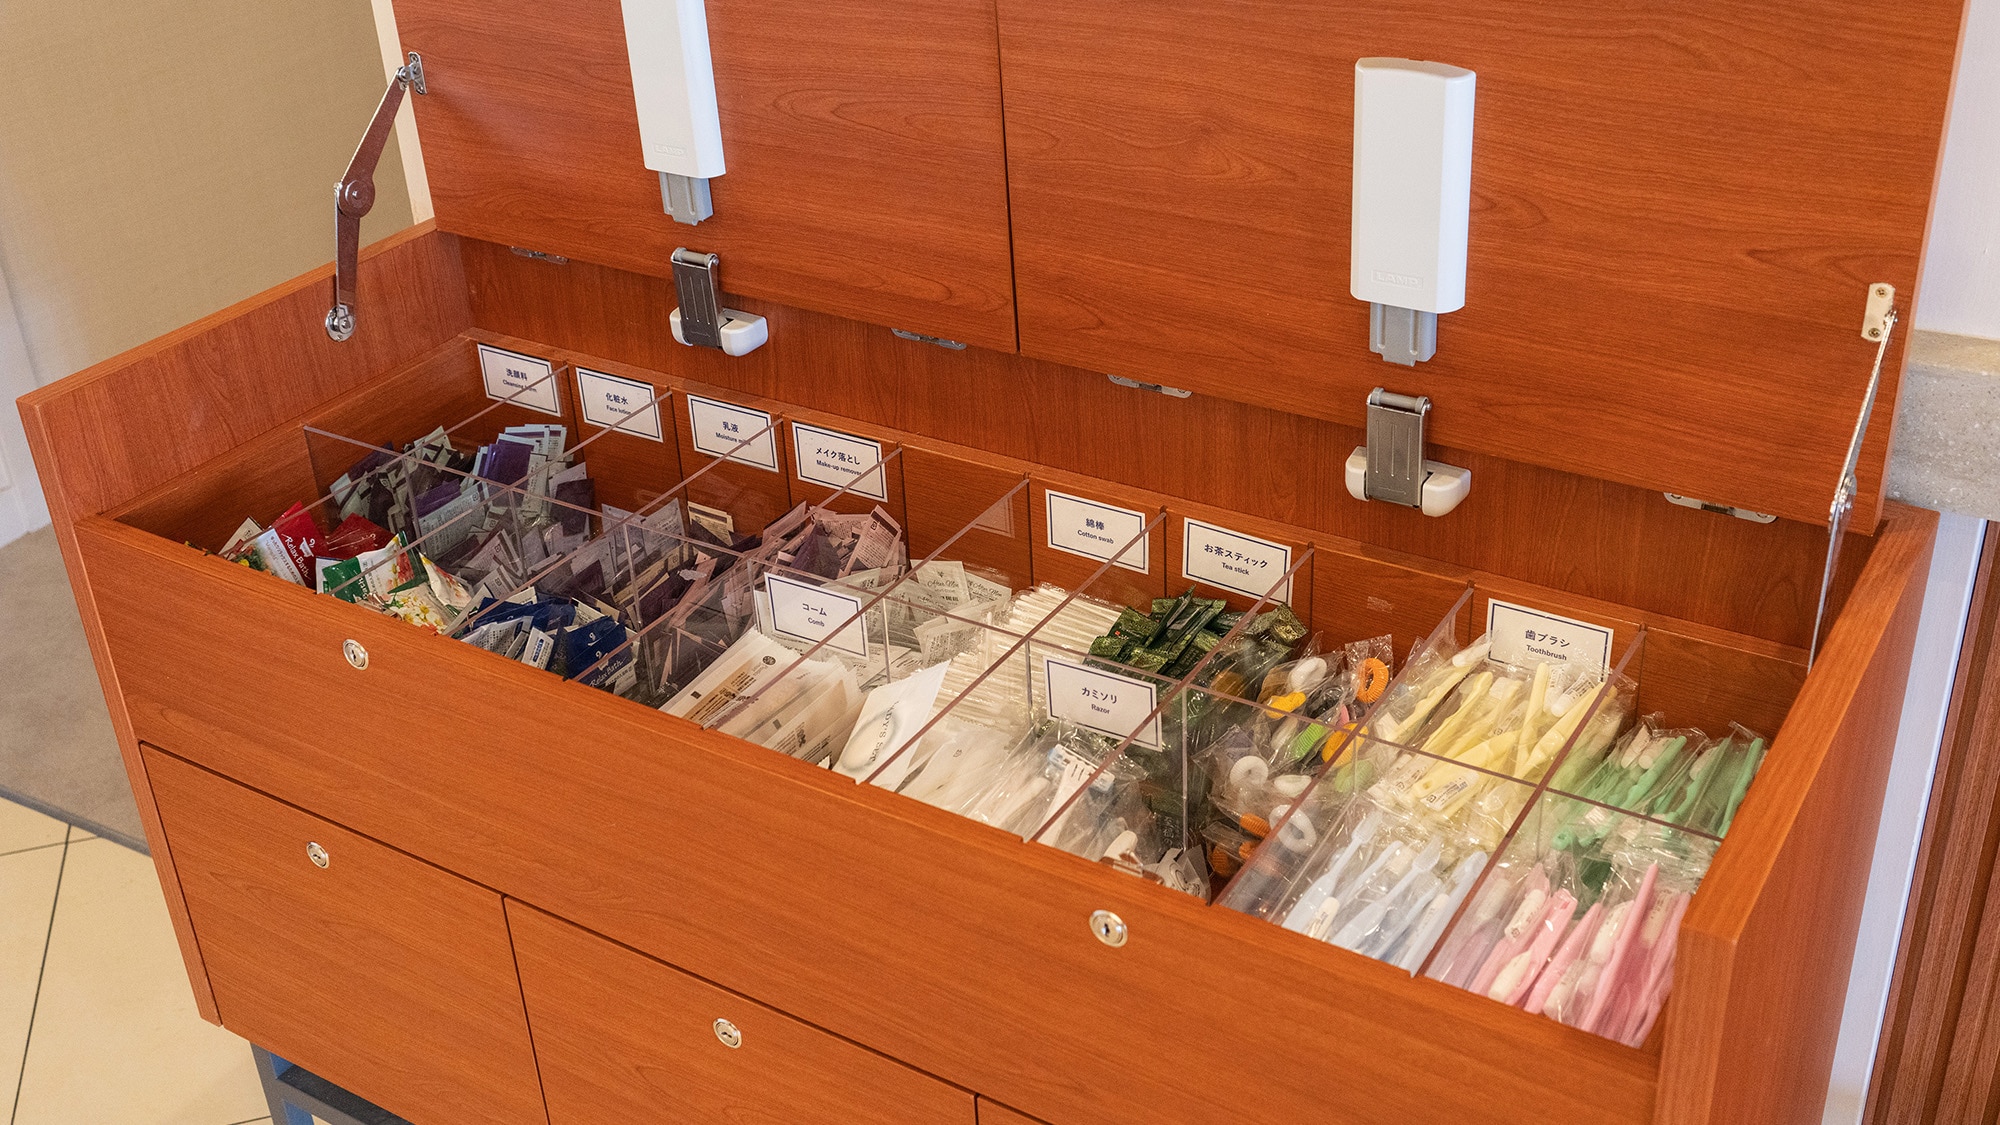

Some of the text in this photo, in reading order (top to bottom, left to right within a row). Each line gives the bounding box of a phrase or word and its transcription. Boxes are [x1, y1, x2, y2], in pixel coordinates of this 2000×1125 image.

[1376, 272, 1419, 287] LAMP
[506, 367, 528, 380] 洗顔料
[605, 392, 628, 405] 化粧水
[606, 404, 631, 415] Face lotion
[722, 421, 739, 433] 乳液
[715, 432, 737, 442] Moisture
[816, 447, 861, 465] メイク落とし
[816, 459, 862, 476] Make-up remover
[1085, 517, 1105, 531] 綿棒
[1077, 529, 1114, 544] Cotton swab
[281, 532, 311, 580] Relax Bath
[1204, 543, 1268, 569] お茶スティック
[1221, 561, 1250, 576] Tea stick
[802, 603, 828, 616] コーム
[807, 617, 825, 628] Comb
[1525, 629, 1571, 648] 歯ブラシ
[1526, 644, 1567, 661] Toothbrush
[1081, 686, 1117, 704] カミソリ
[1091, 703, 1110, 715] Razor
